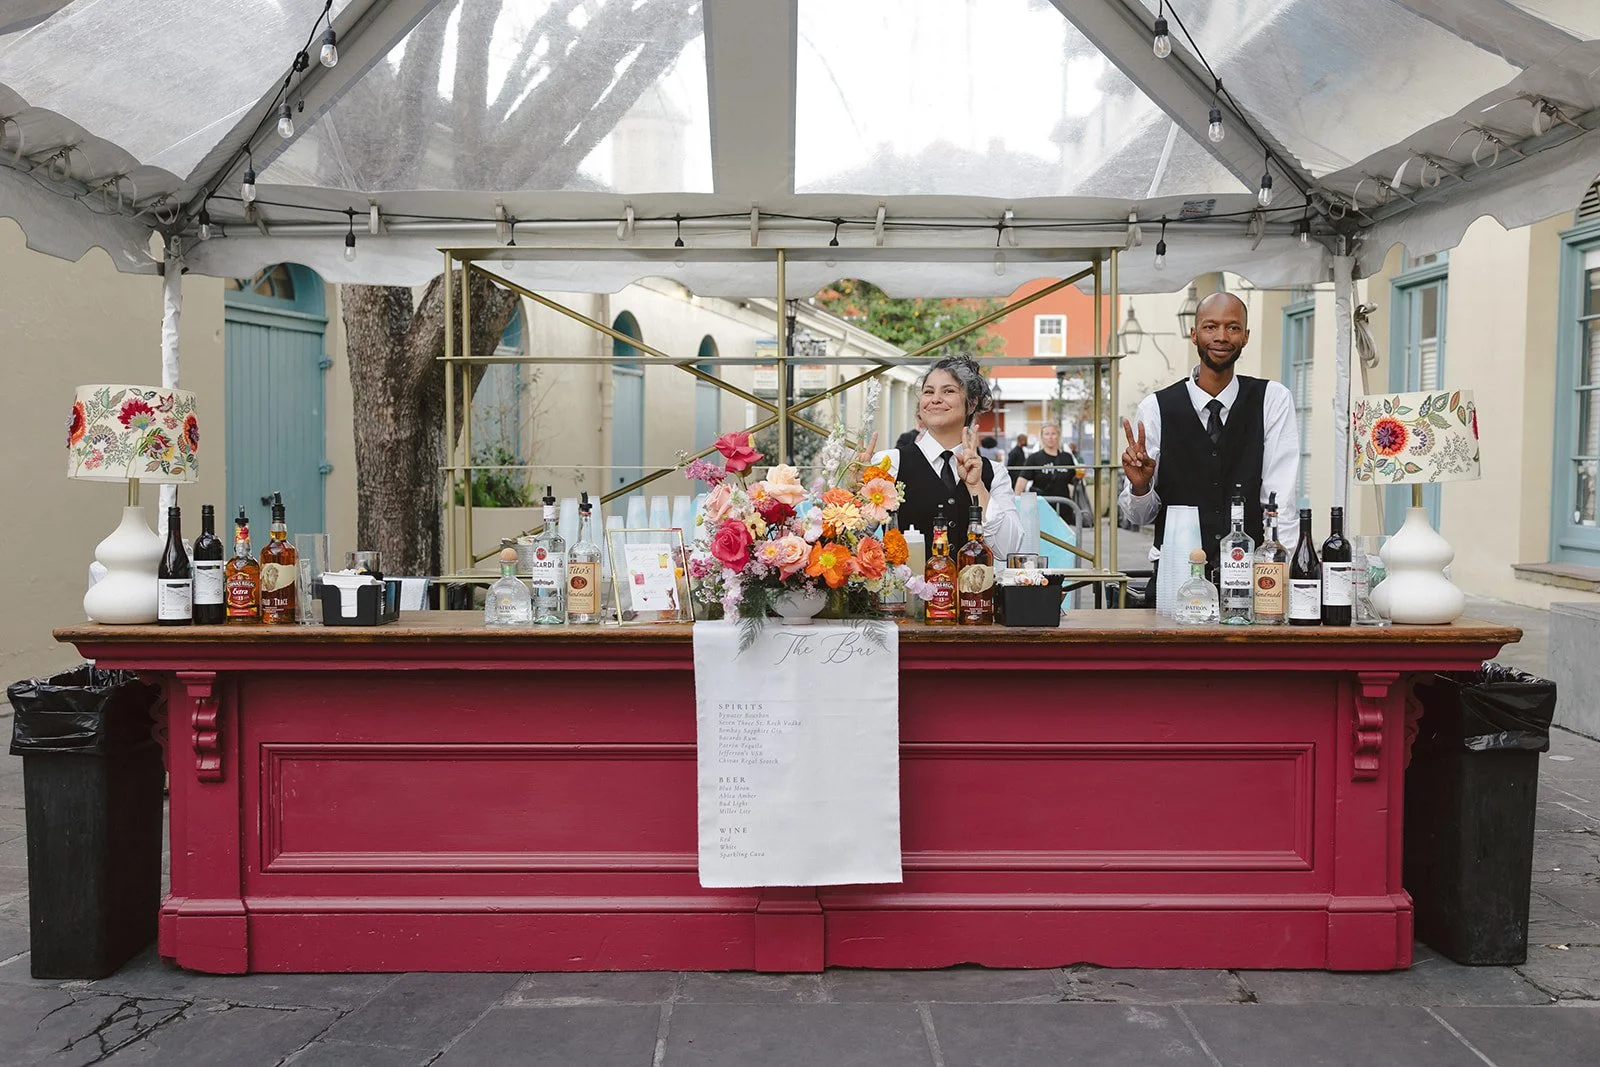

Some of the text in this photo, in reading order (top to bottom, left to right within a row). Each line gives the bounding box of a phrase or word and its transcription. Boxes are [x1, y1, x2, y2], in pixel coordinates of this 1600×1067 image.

[568, 566, 591, 575] Tito's
[1256, 566, 1279, 575] Tito's
[232, 587, 248, 595] Extra
[773, 631, 875, 665] The Bar
[718, 727, 741, 735] Bombay
[741, 742, 763, 750] Tequila
[741, 757, 757, 765] Regal
[720, 851, 748, 859] Sparkling
